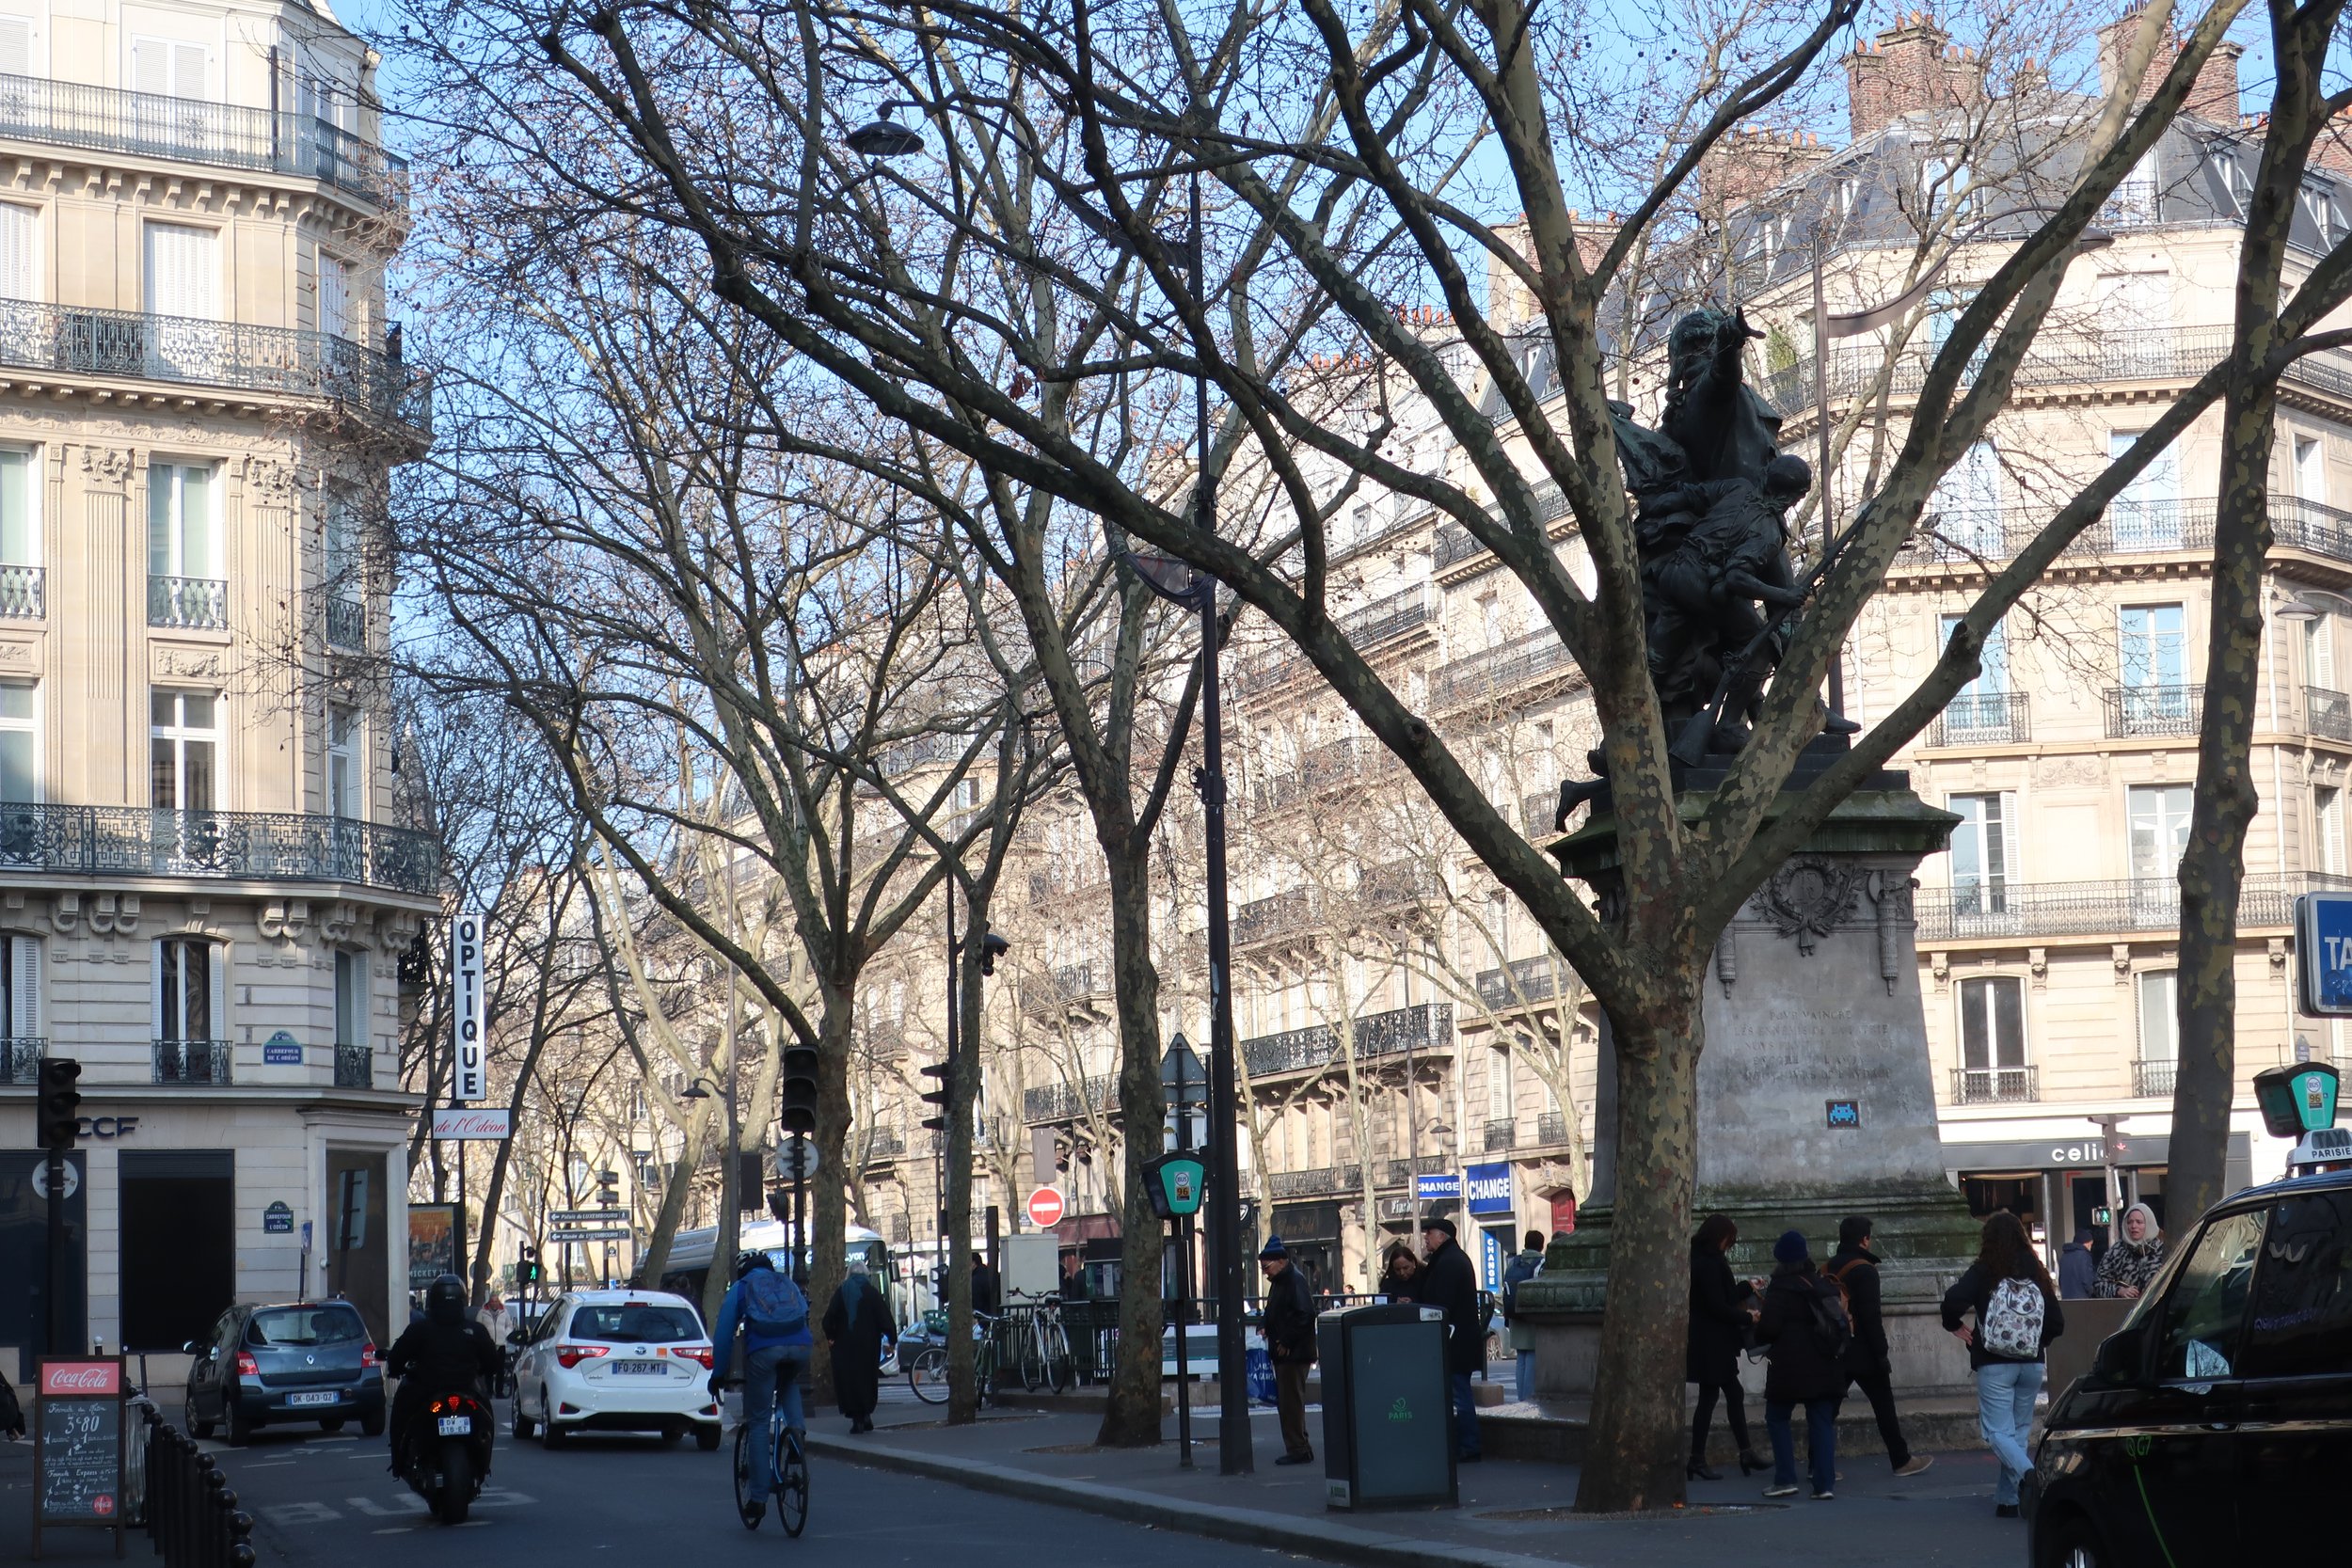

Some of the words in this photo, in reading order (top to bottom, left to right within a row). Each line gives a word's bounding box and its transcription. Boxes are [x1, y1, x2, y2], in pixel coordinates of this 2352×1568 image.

[459, 921, 478, 1094] OPTIQUE
[2310, 1093, 2321, 1102] 96
[435, 1119, 450, 1133] de
[453, 1115, 506, 1133] l'Odéon
[2313, 1131, 2350, 1148] TAXI
[1177, 1187, 1188, 1196] 96
[1469, 1178, 1510, 1200] CHANGE
[1487, 1238, 1496, 1286] CHANGE
[51, 1369, 111, 1389] Coca-Cola
